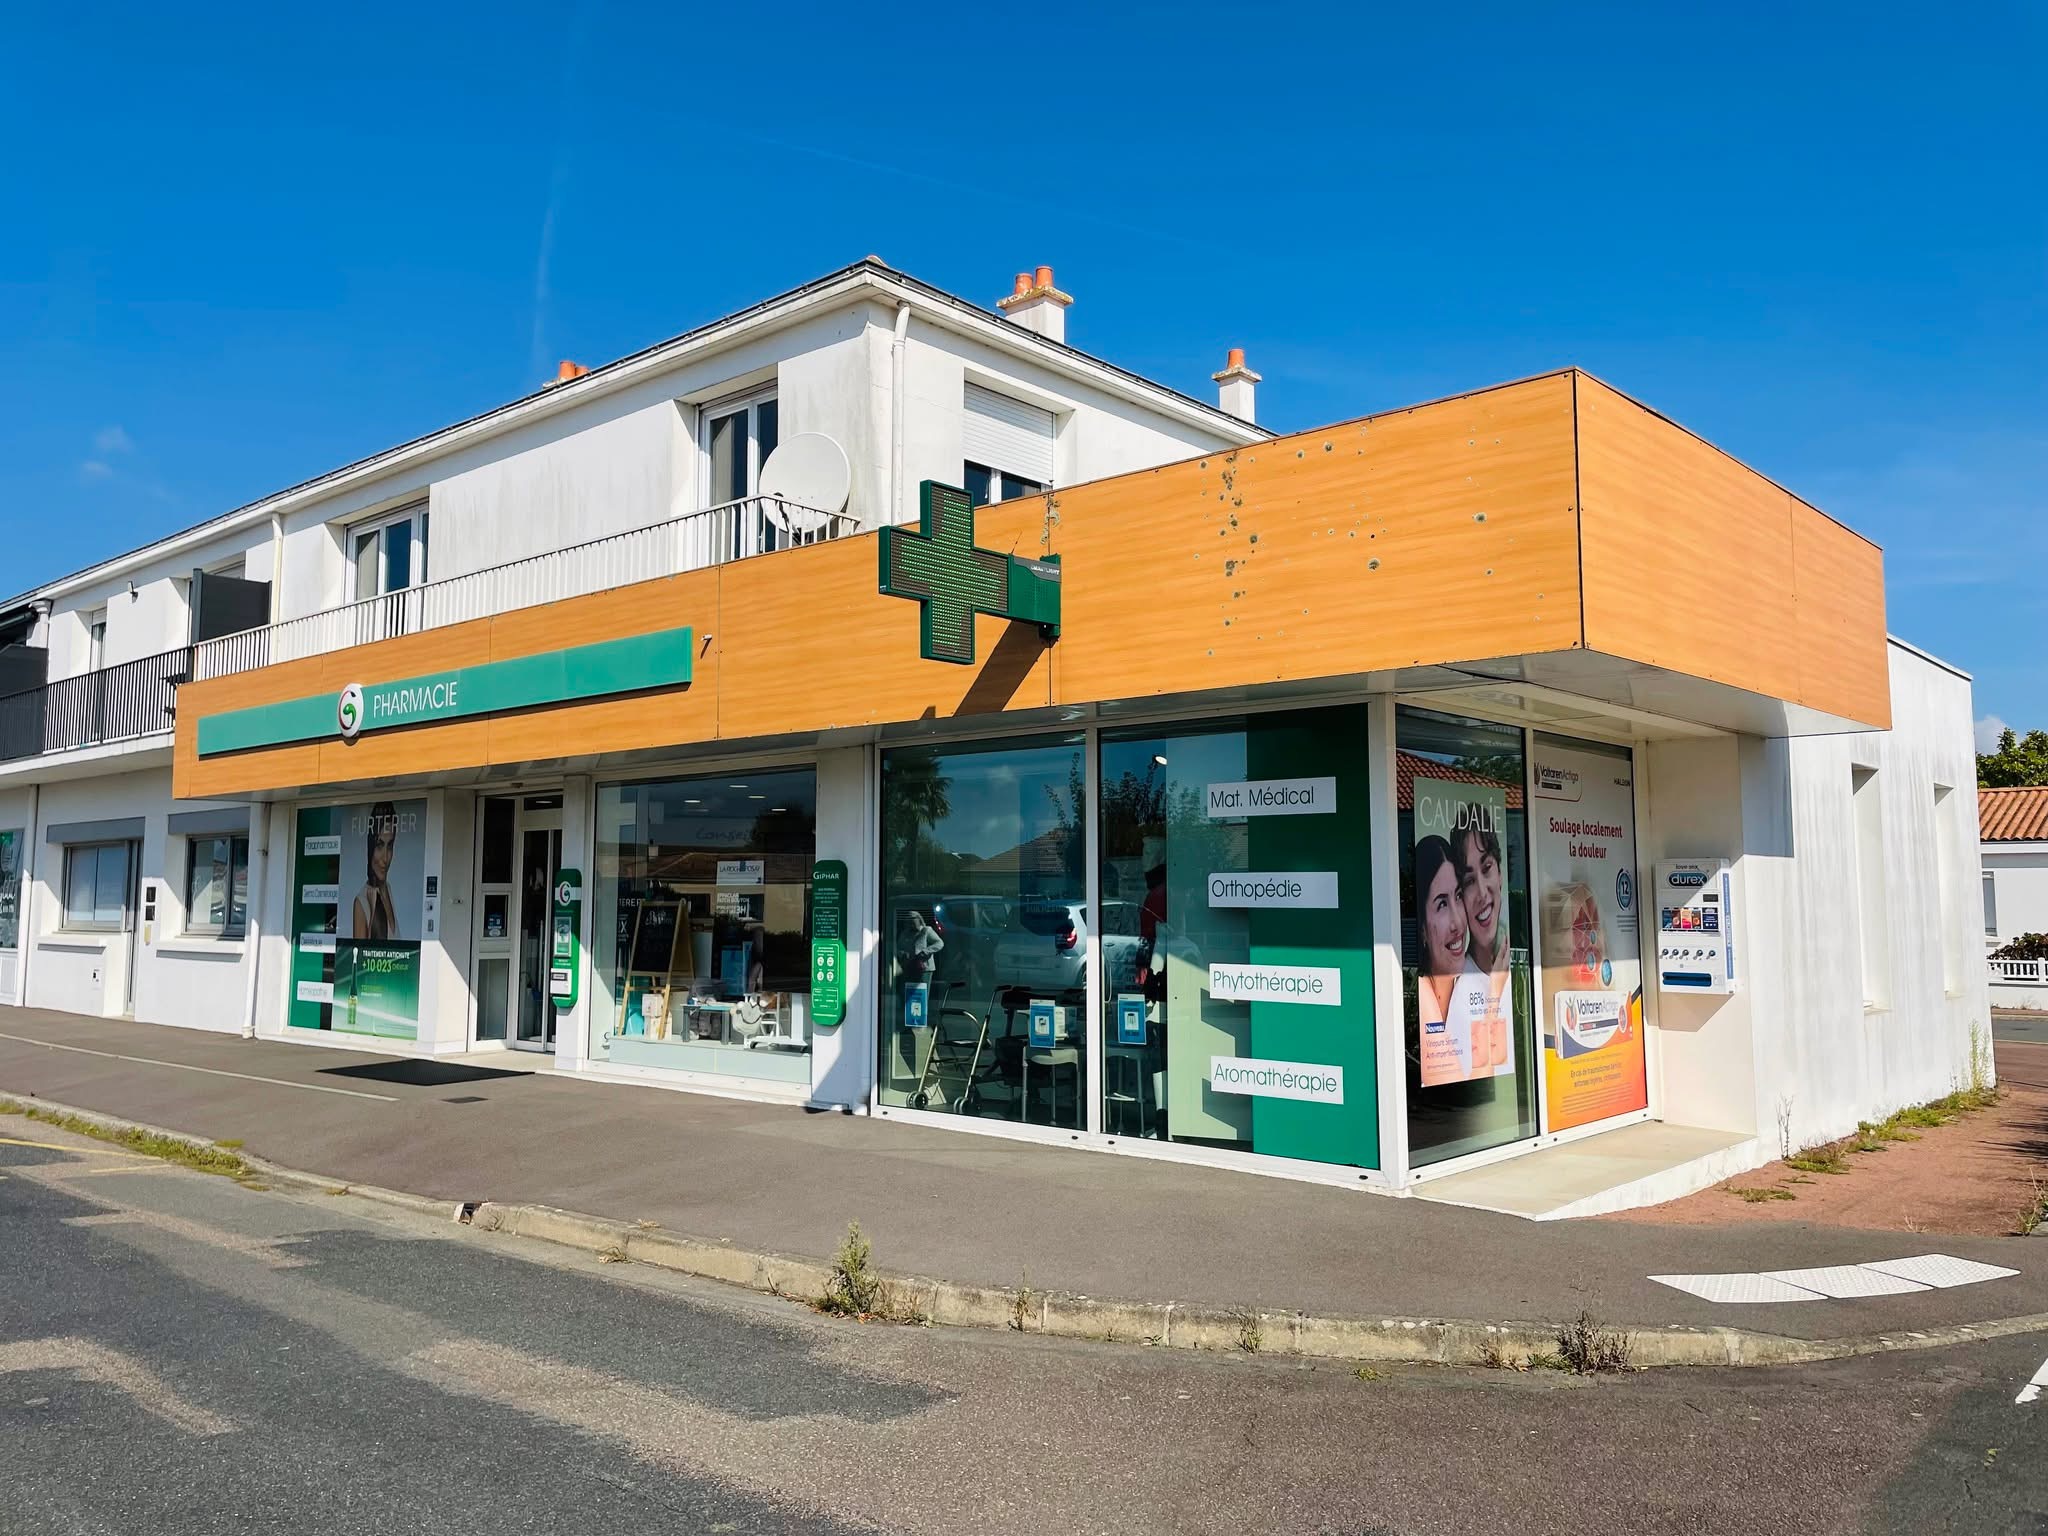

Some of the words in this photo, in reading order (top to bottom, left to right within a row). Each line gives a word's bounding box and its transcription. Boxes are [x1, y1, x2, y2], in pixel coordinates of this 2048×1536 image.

[373, 681, 457, 718] PHARMACIE
[1211, 790, 1243, 809] Mat.
[1249, 786, 1314, 806] Médical
[352, 813, 417, 834] FURTERER
[1549, 817, 1581, 838] Soulage
[1582, 820, 1623, 839] localement
[1569, 841, 1577, 857] la
[1578, 842, 1607, 859] douleur
[1211, 878, 1302, 901] Orthopédie
[1621, 880, 1630, 895] 12
[1671, 874, 1705, 885] durex
[363, 950, 386, 958] TRAITEMENT
[1213, 970, 1323, 996] Phytothérapie
[1469, 991, 1484, 1006] 86%
[1214, 1063, 1337, 1094] Aromathérapie
